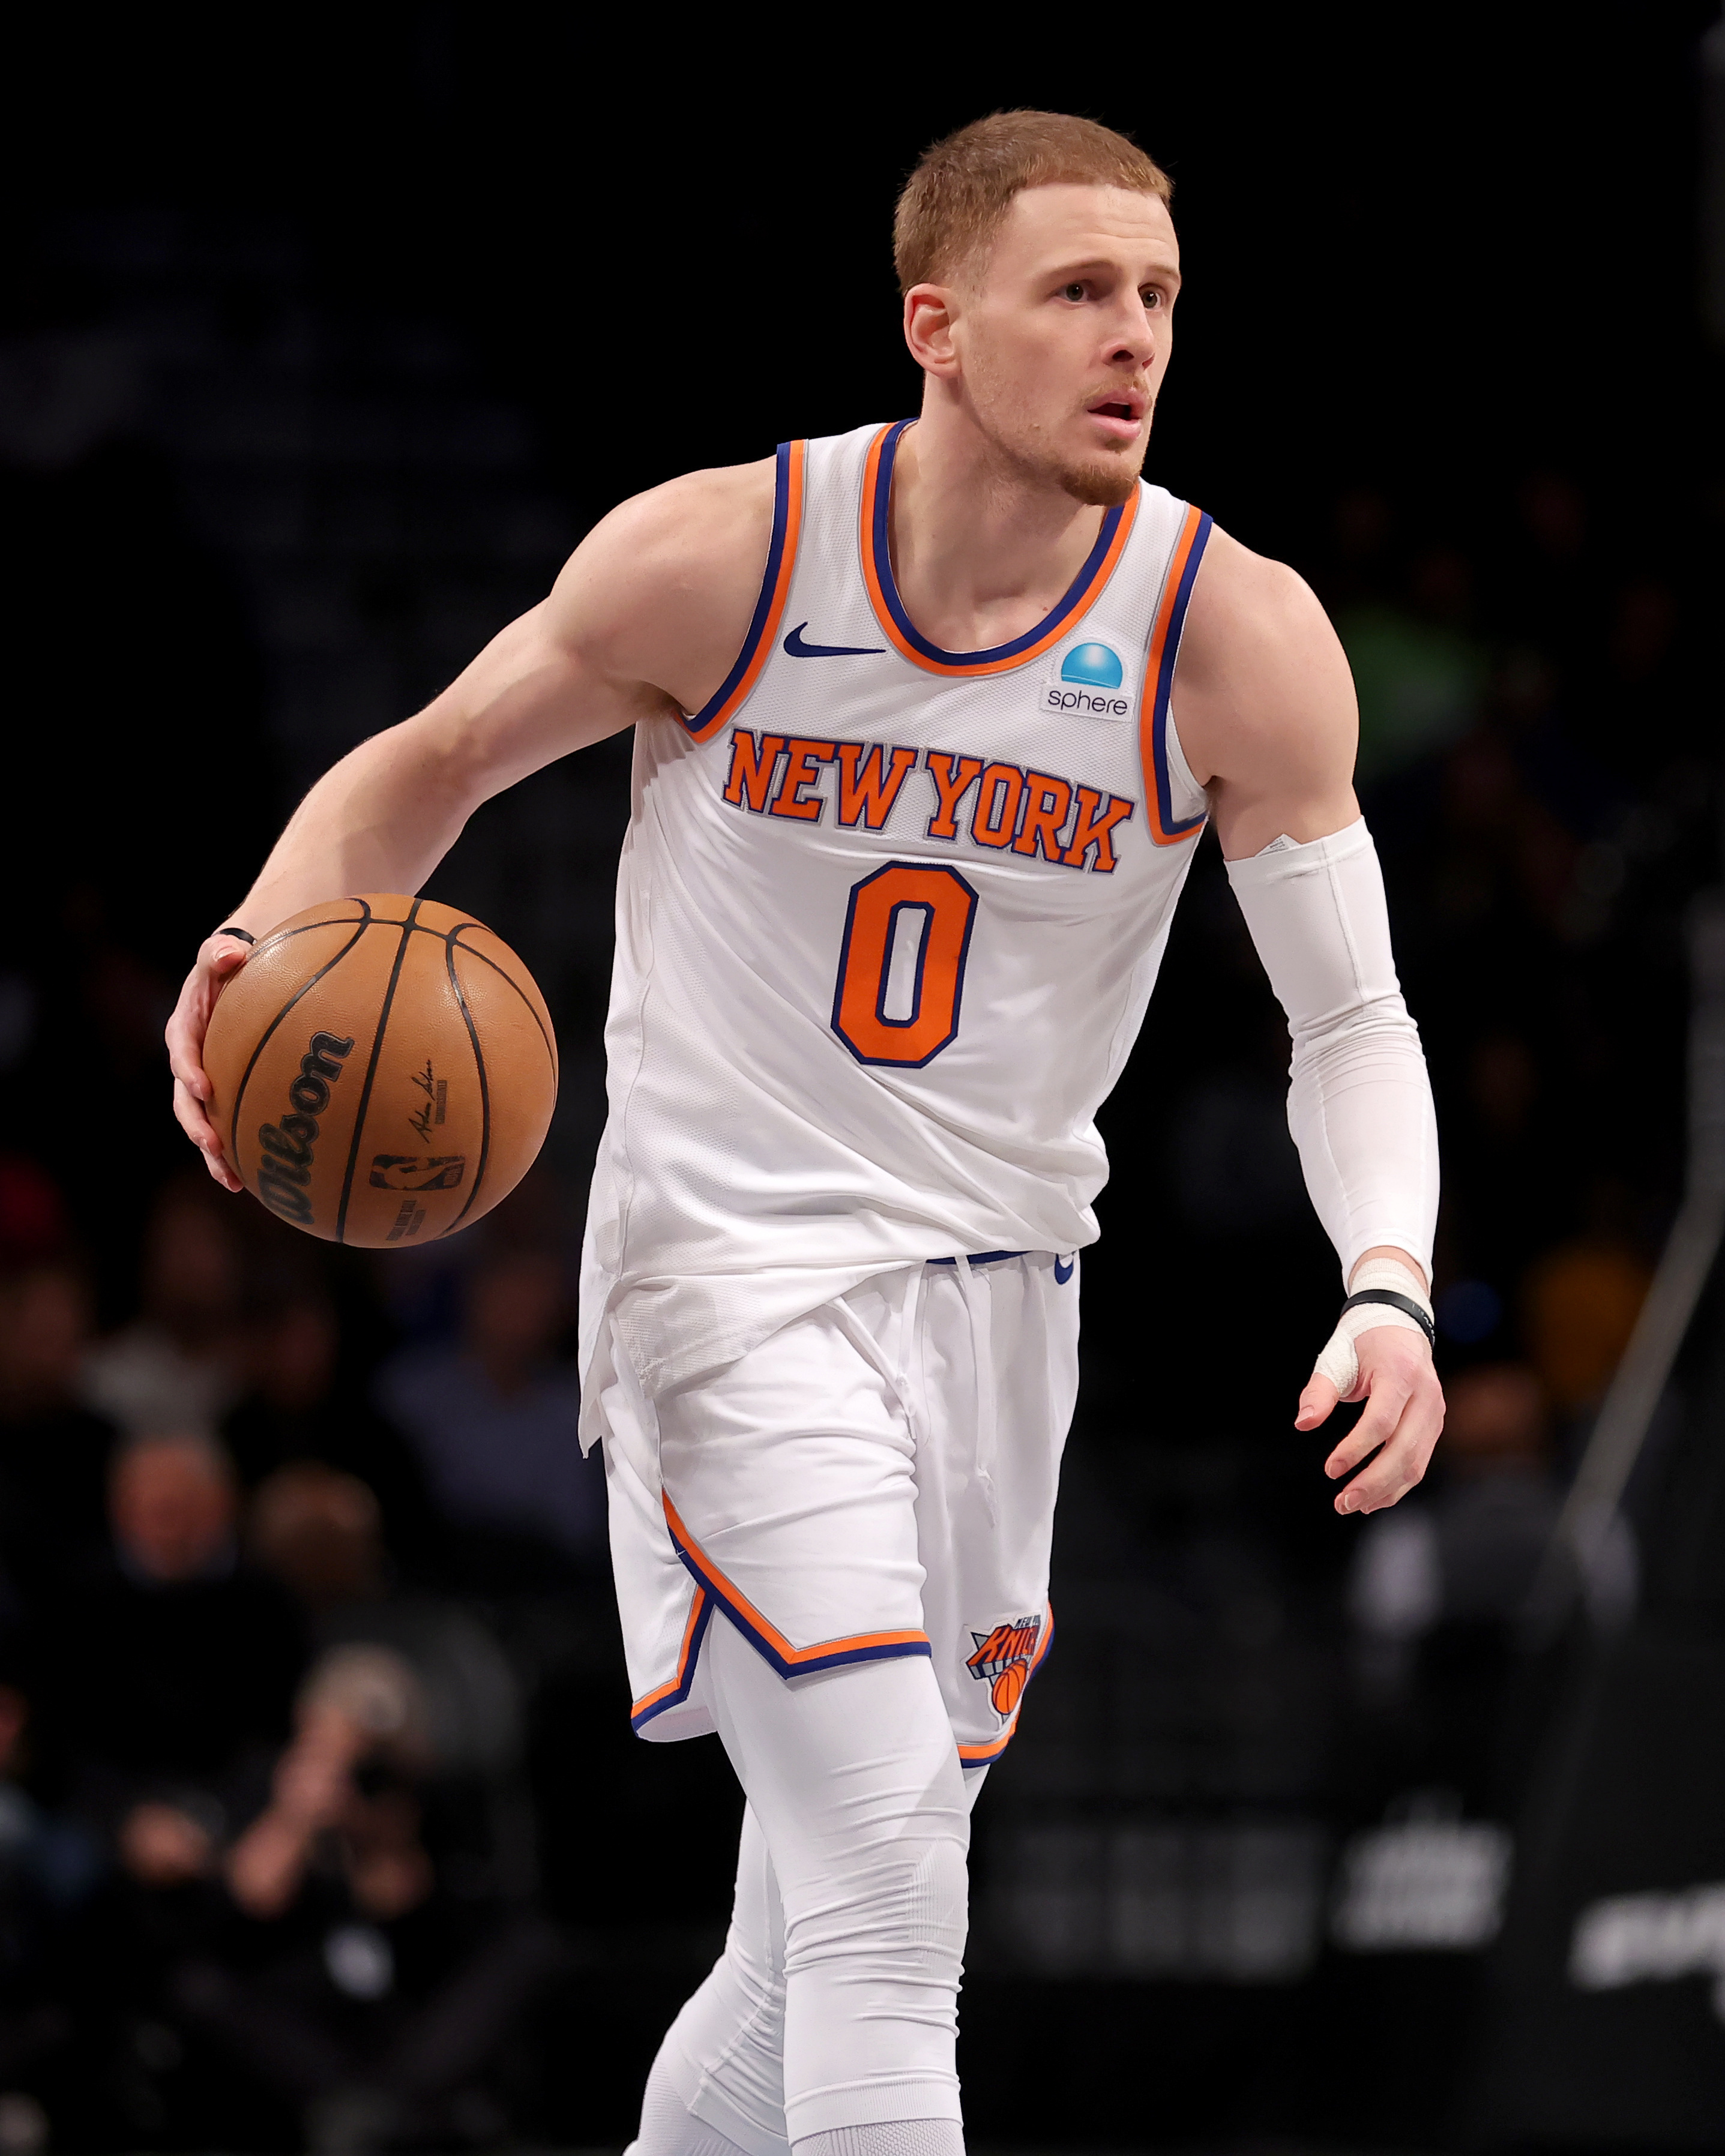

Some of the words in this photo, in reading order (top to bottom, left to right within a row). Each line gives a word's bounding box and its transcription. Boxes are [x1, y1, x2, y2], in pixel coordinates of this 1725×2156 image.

[1048, 690, 1128, 715] sphere
[723, 728, 918, 830] NEW
[926, 750, 1135, 874] YORK
[831, 860, 979, 1068] 0
[257, 1031, 355, 1225] Wilson
